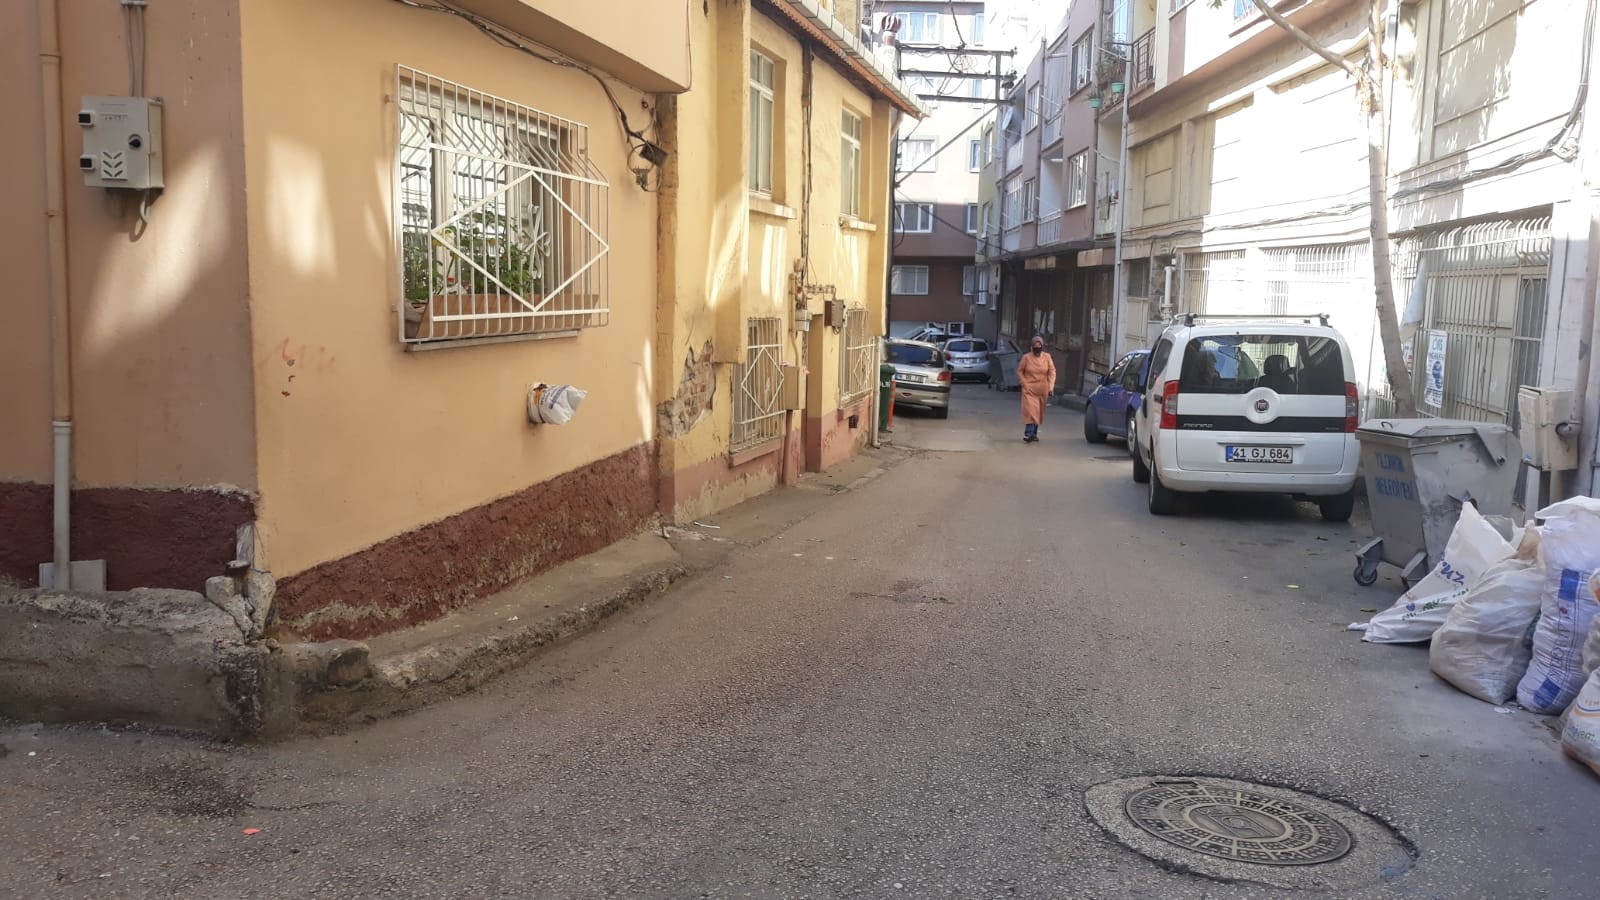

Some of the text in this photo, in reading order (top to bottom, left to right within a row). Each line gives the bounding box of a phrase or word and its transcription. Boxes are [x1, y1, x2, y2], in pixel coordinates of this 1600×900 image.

[1233, 447, 1290, 459] 41 GJ 684
